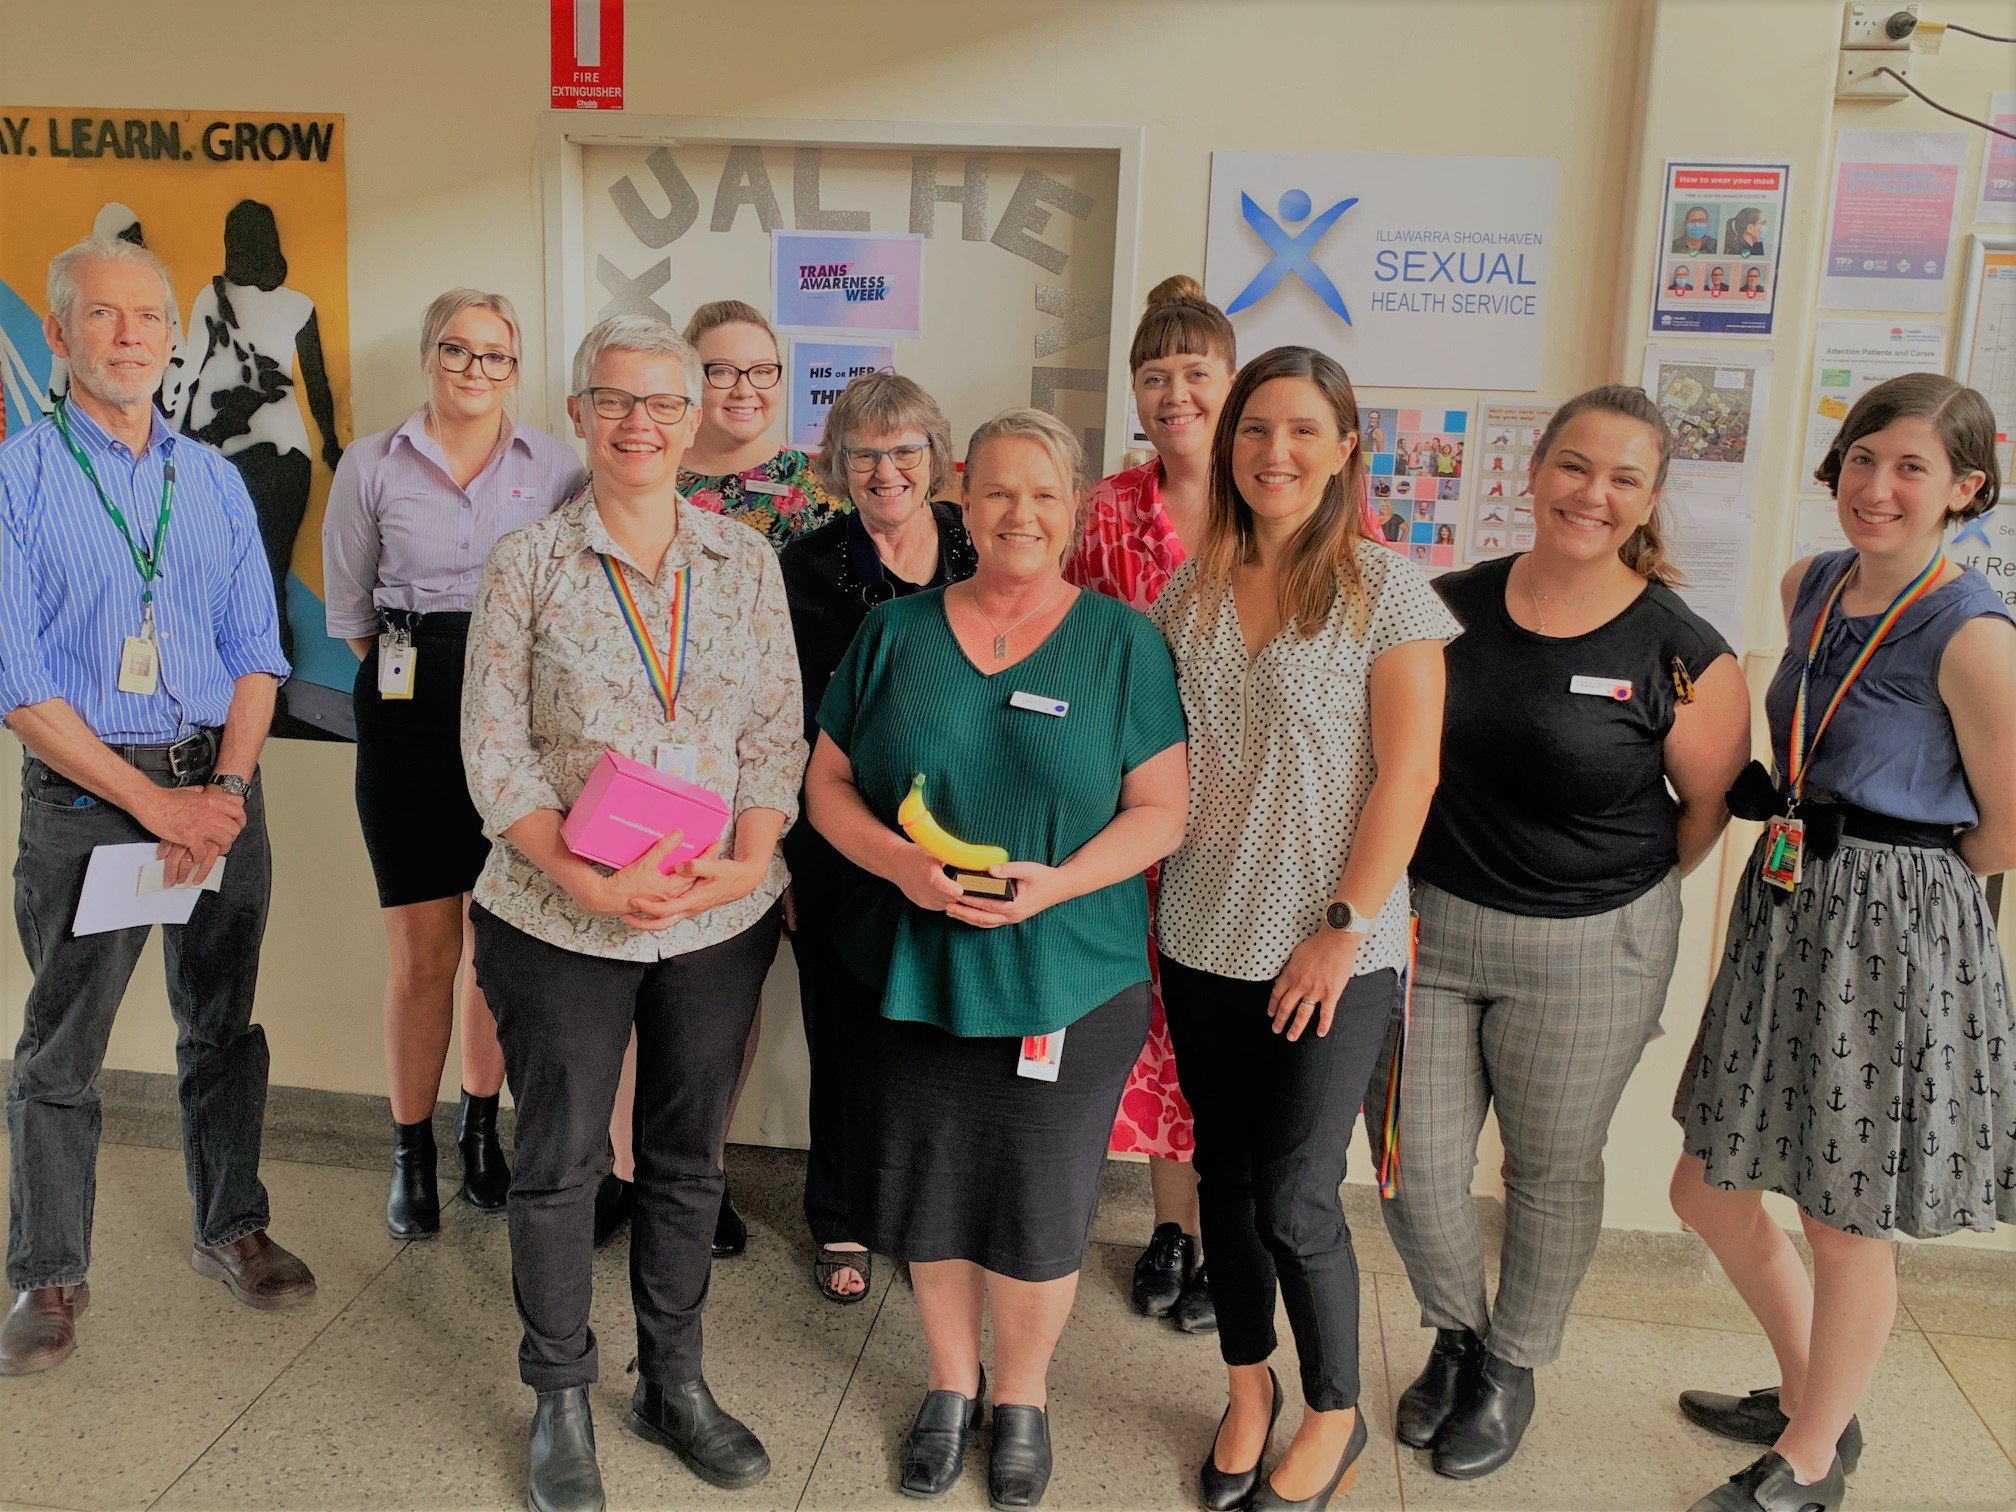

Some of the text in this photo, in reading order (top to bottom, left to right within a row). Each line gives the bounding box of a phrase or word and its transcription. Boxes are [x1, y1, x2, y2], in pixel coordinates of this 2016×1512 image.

[573, 72, 600, 83] FIRE
[551, 86, 622, 97] EXTINGUISHER
[48, 118, 194, 161] LEARN.
[202, 121, 334, 162] GROW
[1679, 175, 1775, 188] How to wear your mask
[1376, 230, 1543, 245] ILLAWARRA SHOALHAVEN
[800, 264, 847, 278] TRANS
[1374, 249, 1537, 285] SEXUAL
[800, 276, 885, 290] AWARENESS
[845, 289, 885, 301] WEEK
[1371, 292, 1537, 315] HEALTH SERVICE
[1826, 347, 1860, 355] Attention
[1862, 348, 1892, 356] Patients
[1894, 349, 1909, 357] and
[809, 367, 832, 378] HIS
